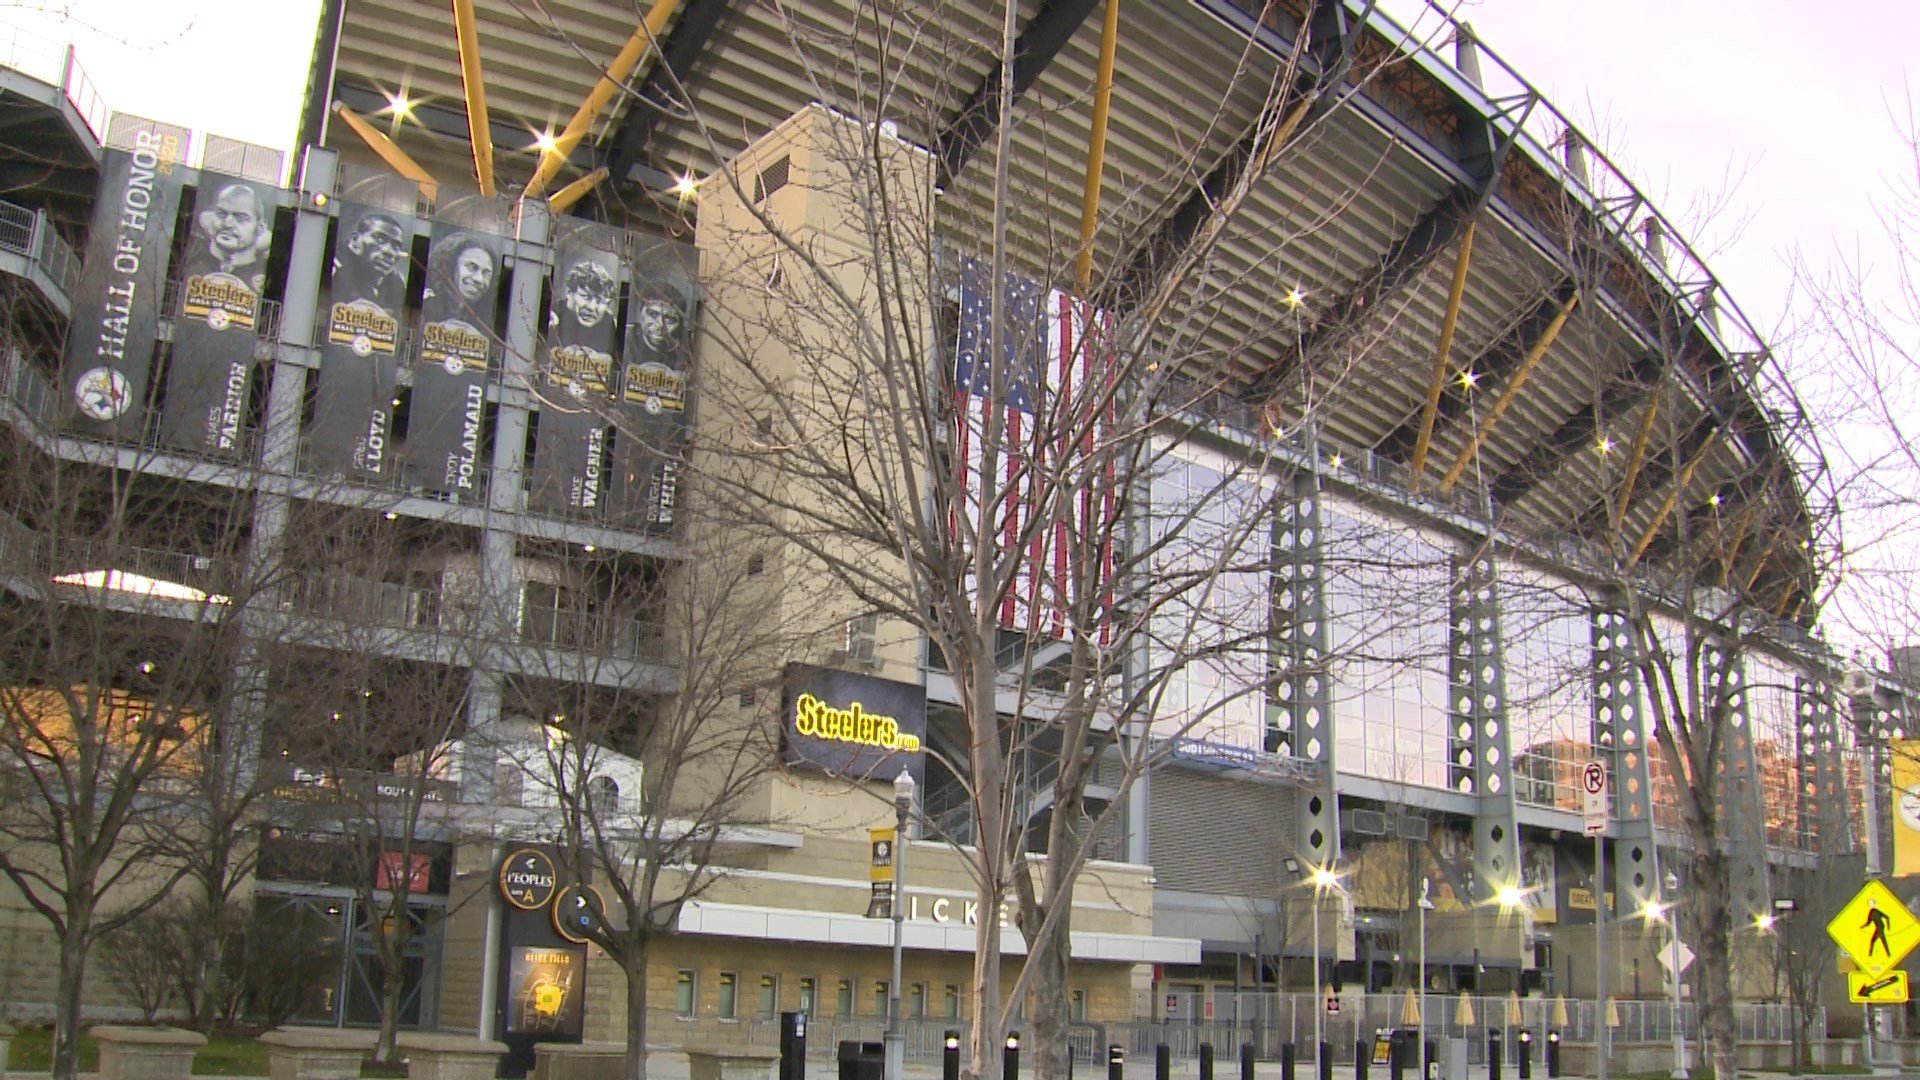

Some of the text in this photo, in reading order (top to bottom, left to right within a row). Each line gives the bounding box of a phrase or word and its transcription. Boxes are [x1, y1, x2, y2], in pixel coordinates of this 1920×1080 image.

[98, 130, 162, 358] HALL OF HONOR
[189, 276, 255, 305] Steelers
[335, 306, 395, 332] Steelers
[425, 324, 487, 350] Steelers
[628, 366, 685, 391] Steelers
[458, 384, 483, 489] POLAMALU
[583, 427, 603, 508] WAGNER
[507, 872, 553, 887] PEOPLES
